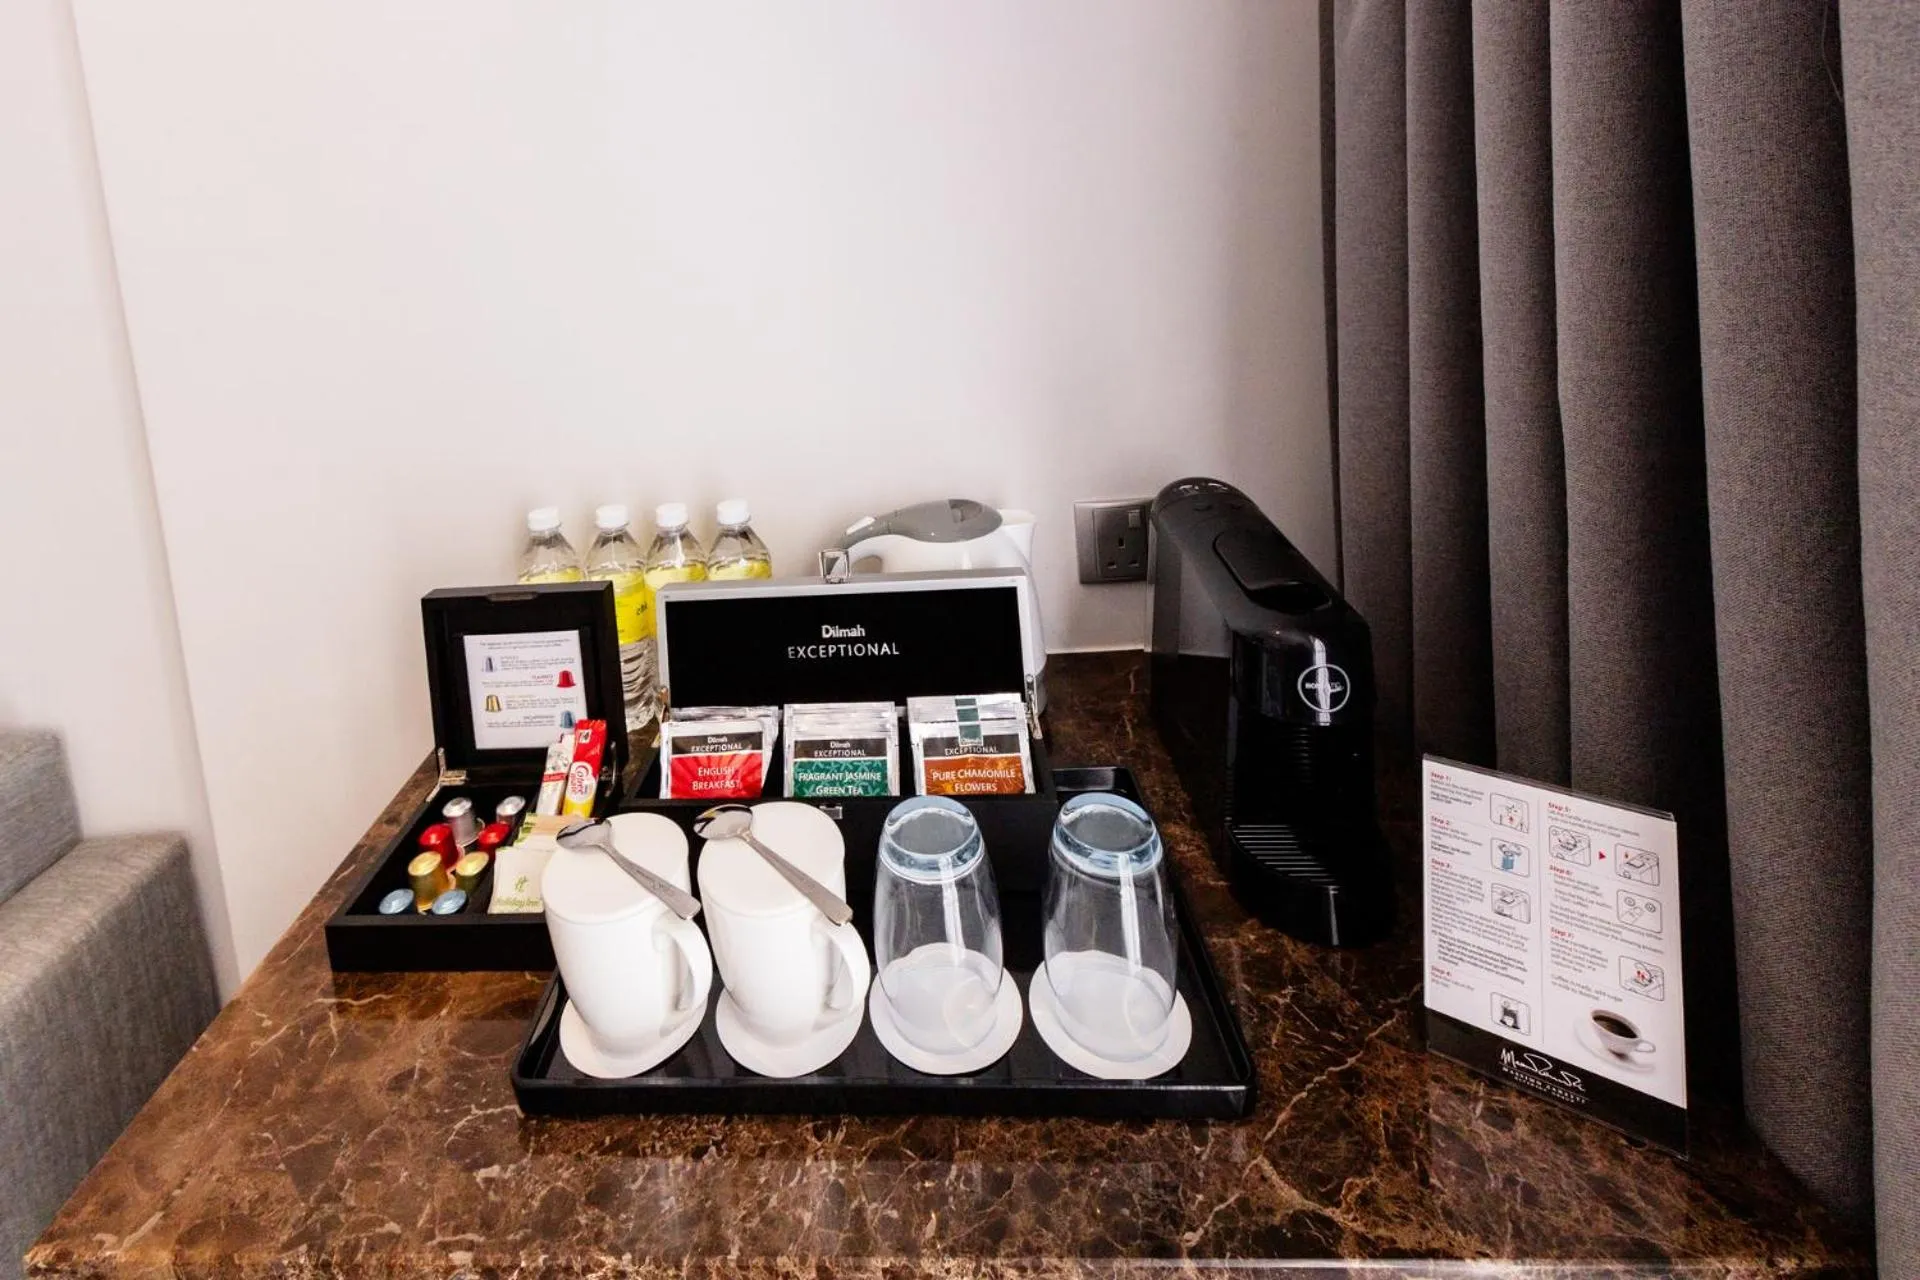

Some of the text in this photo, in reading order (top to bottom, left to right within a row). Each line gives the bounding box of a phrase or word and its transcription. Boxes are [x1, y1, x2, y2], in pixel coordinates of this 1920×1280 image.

[821, 624, 866, 639] Dilmah
[787, 641, 900, 659] EXCEPTIONAL
[707, 736, 728, 744] Dilmah
[830, 740, 851, 749] Dilmah
[691, 743, 742, 753] EXCEPTIONAL
[814, 749, 867, 758] EXCEPTIONAL
[945, 746, 998, 756] EXCEPTIONAL
[697, 766, 735, 777] ENGLISH
[798, 770, 882, 783] FRAGRANT JASMINE
[932, 768, 1016, 782] PURE CHAMOMILE
[692, 779, 742, 791] BREAKFAST
[816, 785, 865, 796] GREEN TEA
[955, 782, 998, 793] FLOWERS
